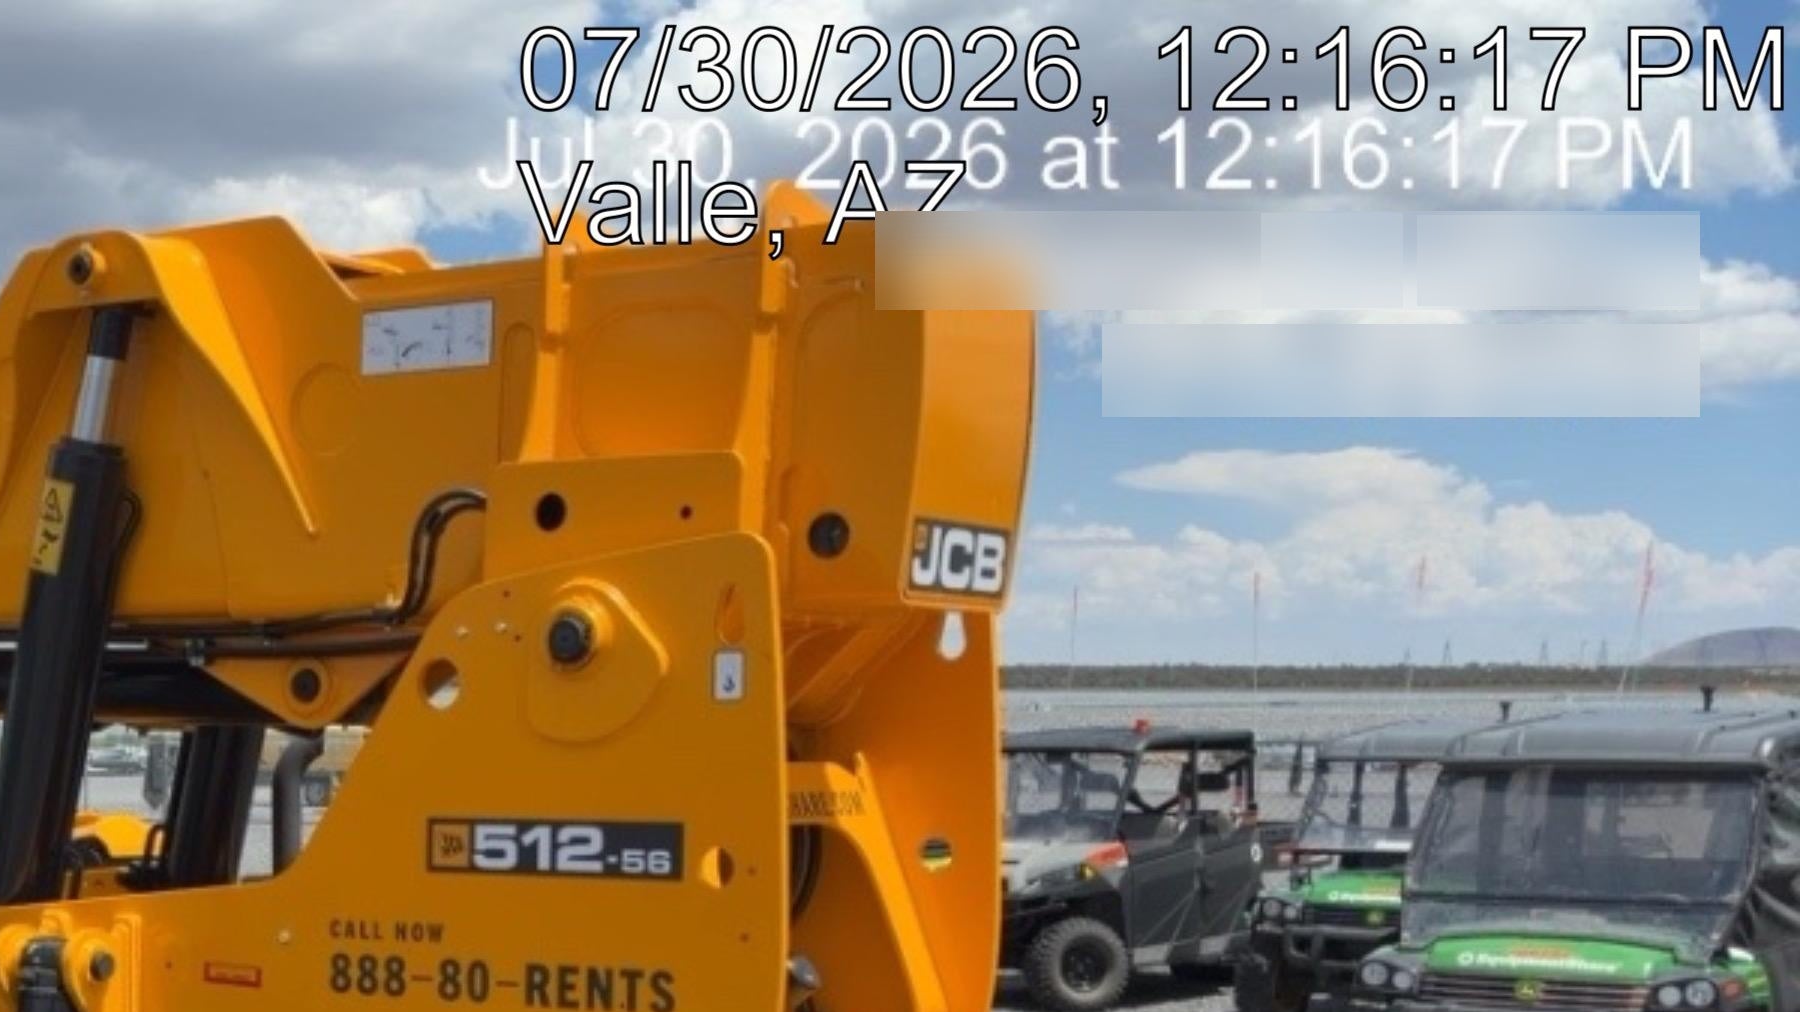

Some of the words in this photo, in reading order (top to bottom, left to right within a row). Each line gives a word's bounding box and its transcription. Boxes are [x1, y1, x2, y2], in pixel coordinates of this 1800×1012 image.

[910, 523, 1007, 594] JCB
[328, 918, 384, 941] CALL
[395, 921, 446, 943] NOW
